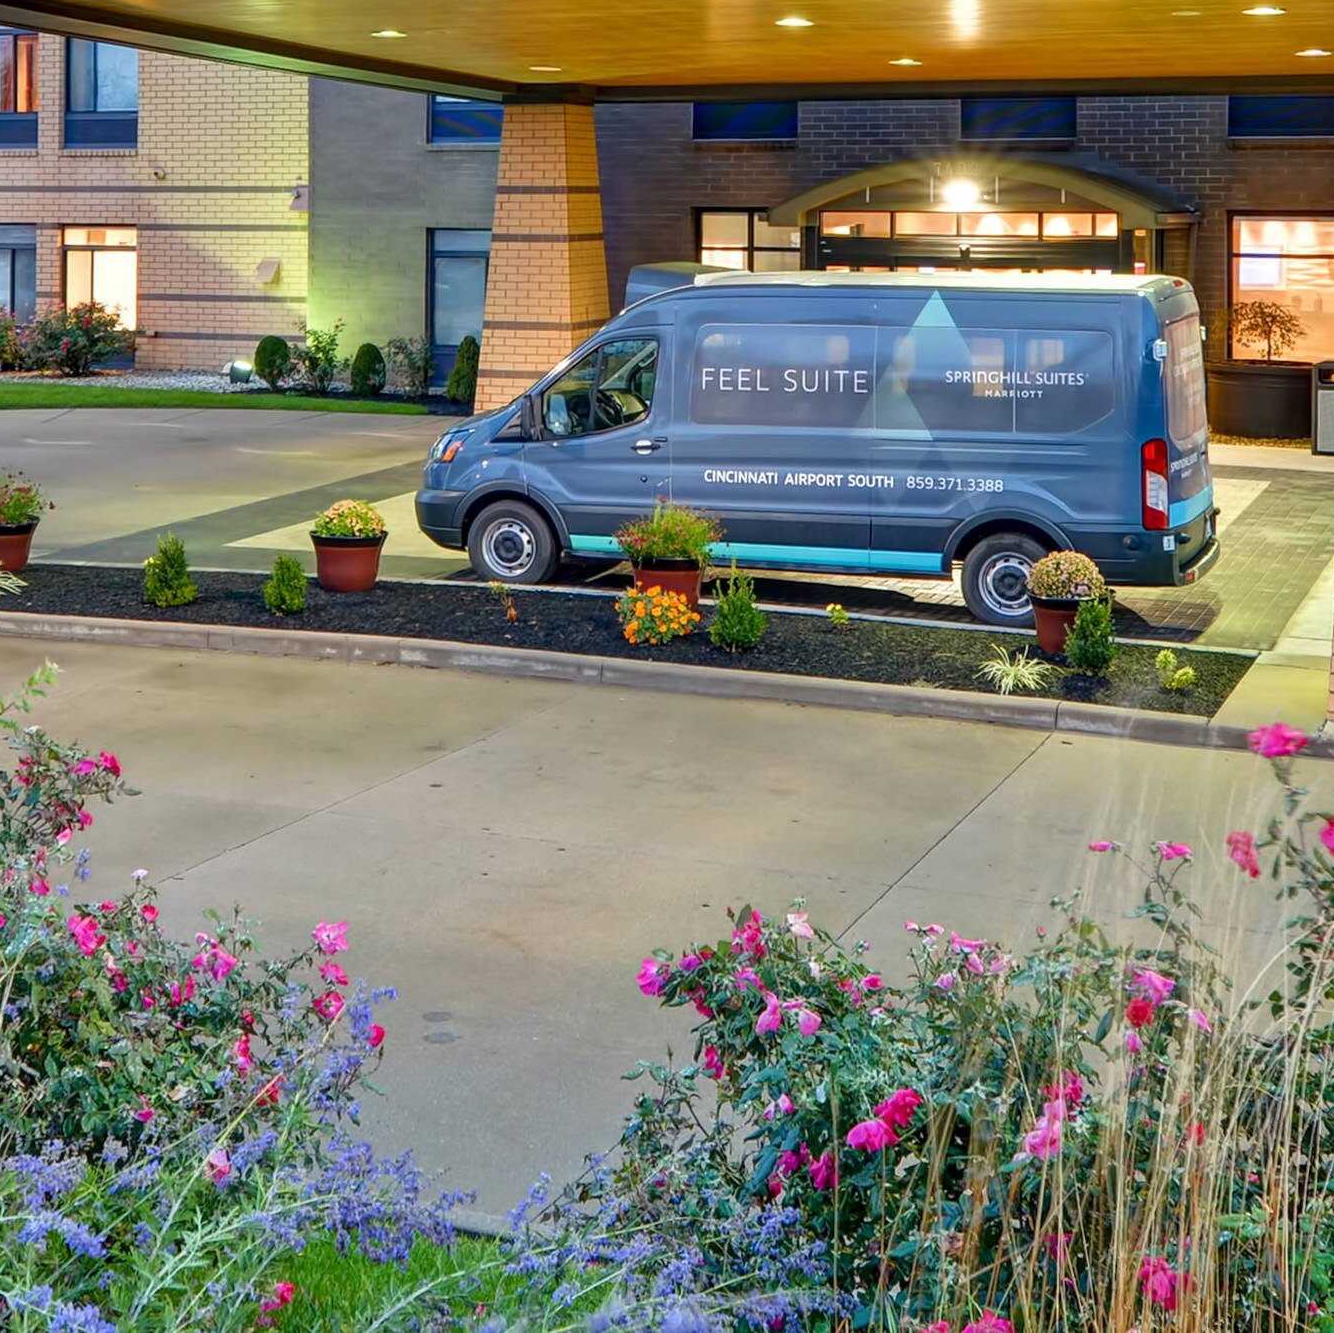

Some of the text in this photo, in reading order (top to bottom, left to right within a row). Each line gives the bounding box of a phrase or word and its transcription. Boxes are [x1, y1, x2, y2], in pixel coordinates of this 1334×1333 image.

[701, 367, 869, 394] FEEL SUITE
[944, 370, 1032, 385] SPRINGHILL
[984, 389, 1044, 399] MARRIOTT
[703, 469, 1004, 493] CINCINNATI AIRPORT SOUTH 859.371.3388
